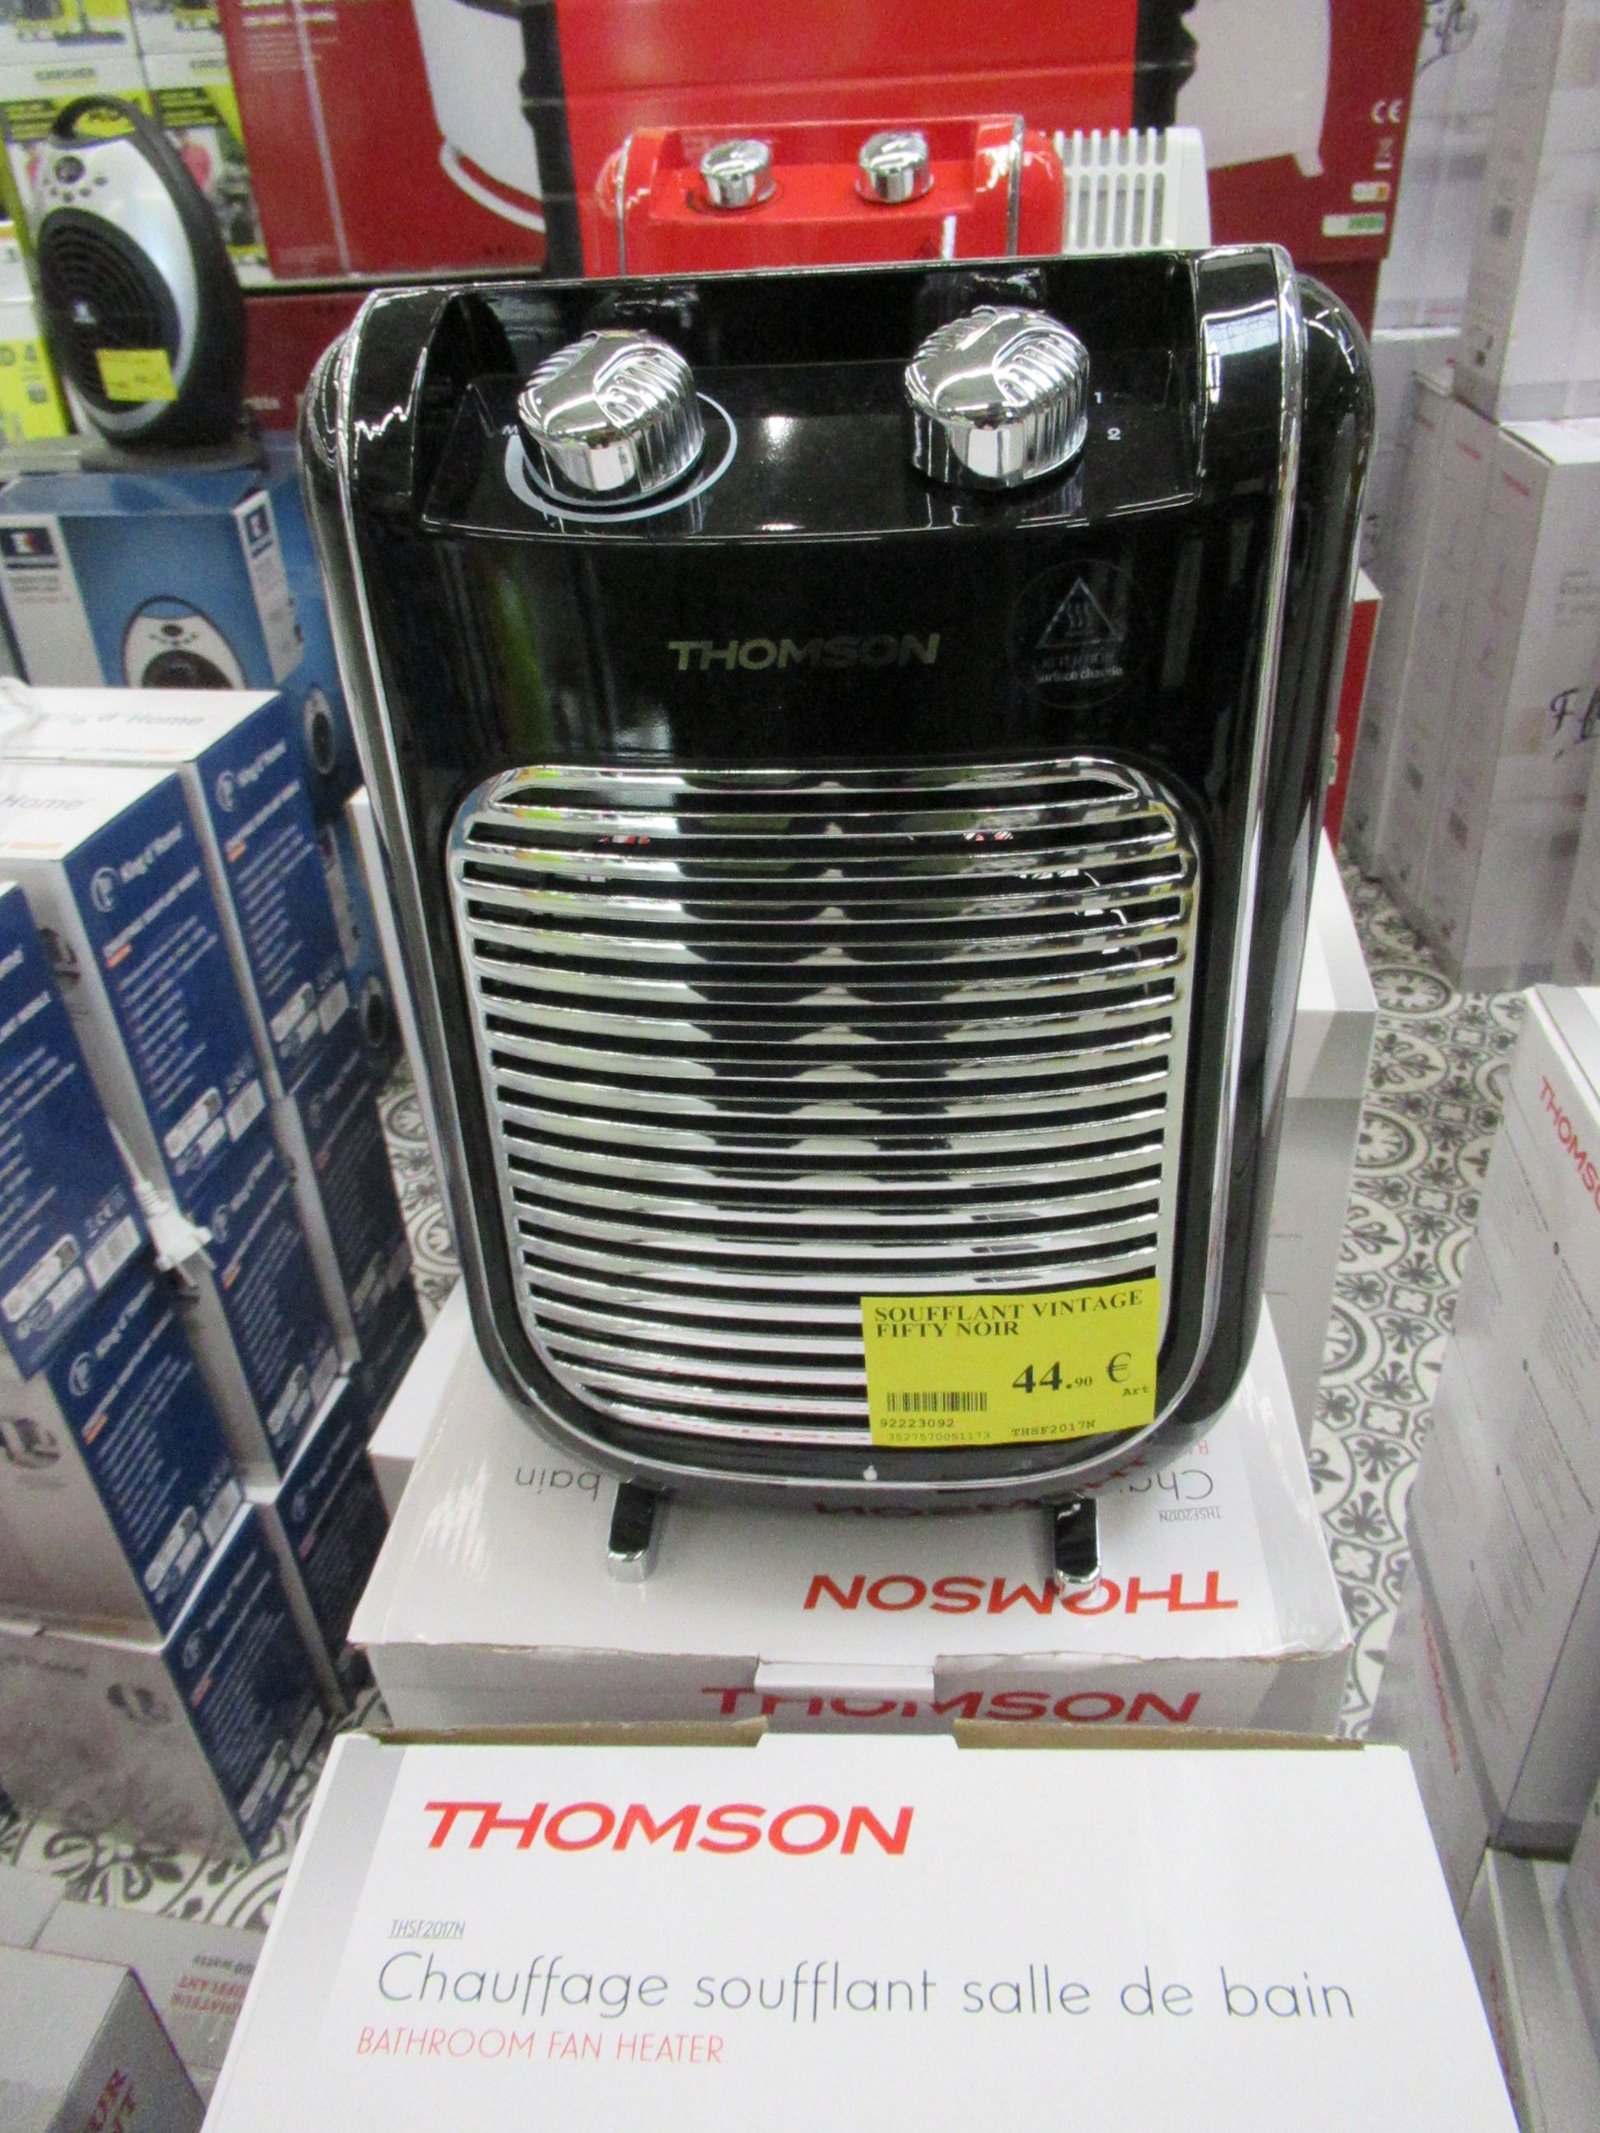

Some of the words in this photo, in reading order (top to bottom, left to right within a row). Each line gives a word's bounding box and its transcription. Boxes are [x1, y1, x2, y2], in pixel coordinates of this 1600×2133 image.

[1107, 427, 1122, 441] 2
[667, 632, 941, 671] THOMSON
[874, 1304, 1025, 1323] SOUFFLANT
[1032, 1289, 1143, 1318] VINTAGE
[876, 1322, 948, 1338] FIFTY
[956, 1320, 1020, 1337] NOIR
[879, 1418, 955, 1429] 92223092
[1011, 1419, 1097, 1437] THSF2017N
[515, 1465, 601, 1501] bain
[803, 1571, 1239, 1617] THOMSON
[424, 1801, 915, 1856] THOMSON
[388, 1919, 466, 1940] THSF2017N
[377, 1951, 669, 2018] Chauffage
[693, 1959, 937, 2023] soufflant
[962, 1963, 1091, 2015] salle
[1119, 1965, 1194, 2016] de
[1219, 1965, 1355, 2018] bain
[356, 2026, 536, 2060] BATHROOM
[546, 2030, 603, 2061] FAN
[615, 2033, 726, 2065] HEATER
